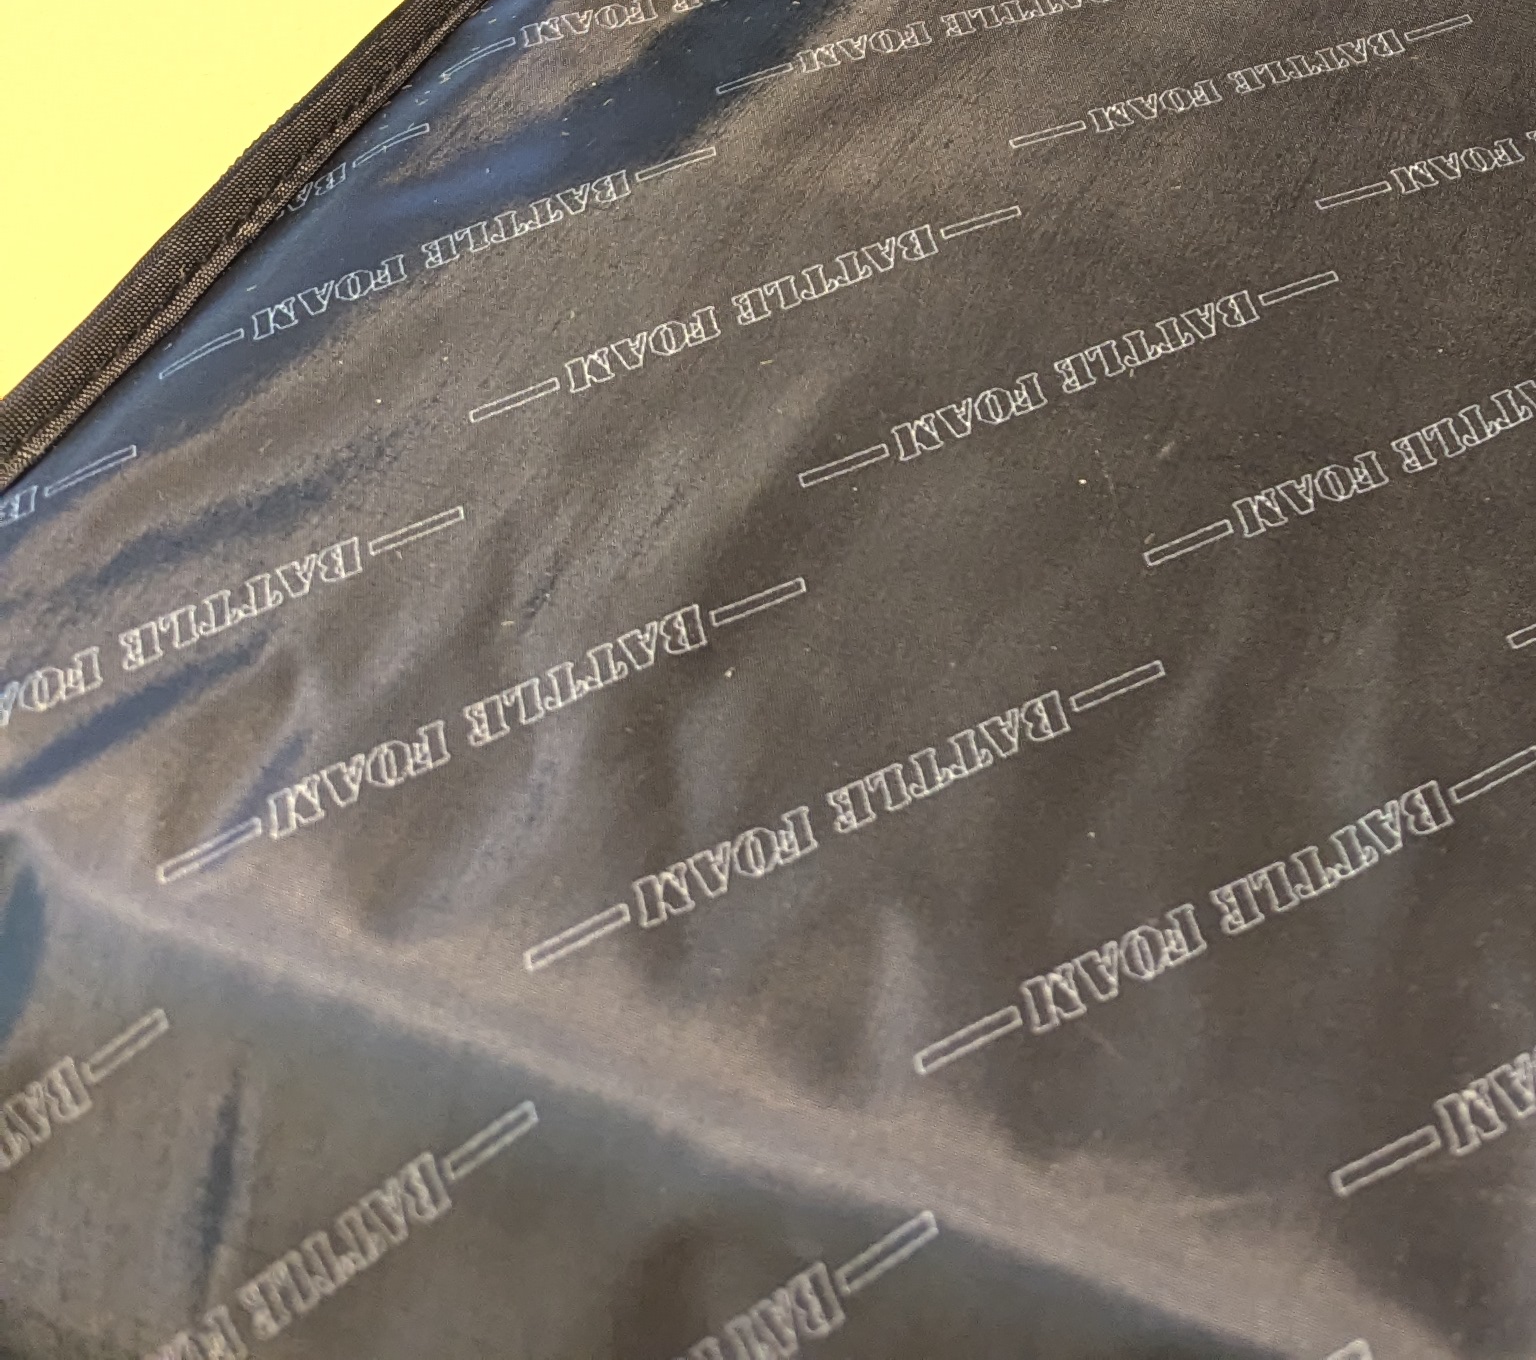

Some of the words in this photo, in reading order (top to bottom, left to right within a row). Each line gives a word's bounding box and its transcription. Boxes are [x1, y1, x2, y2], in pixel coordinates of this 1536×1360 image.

[798, 20, 932, 73] FOAM
[1228, 29, 1406, 95] BATTLE
[1087, 80, 1222, 133] FOAM
[1389, 138, 1525, 195] FOAM
[421, 169, 631, 270] BATTLE
[252, 254, 407, 341] FOAM
[732, 224, 938, 325] BATTLE
[565, 306, 721, 393] FOAM
[1054, 290, 1260, 394] BATTLE
[891, 372, 1048, 461] FOAM
[1232, 451, 1390, 538] FOAM
[118, 537, 362, 671] BATTLE
[463, 604, 708, 747] BATTLE
[267, 719, 451, 840] FOAM
[826, 690, 1072, 833] BATTLE
[631, 806, 818, 929] FOAM
[1210, 780, 1454, 935] BATTLE
[1019, 903, 1207, 1034] FOAM
[236, 1151, 453, 1341] BATTLE
